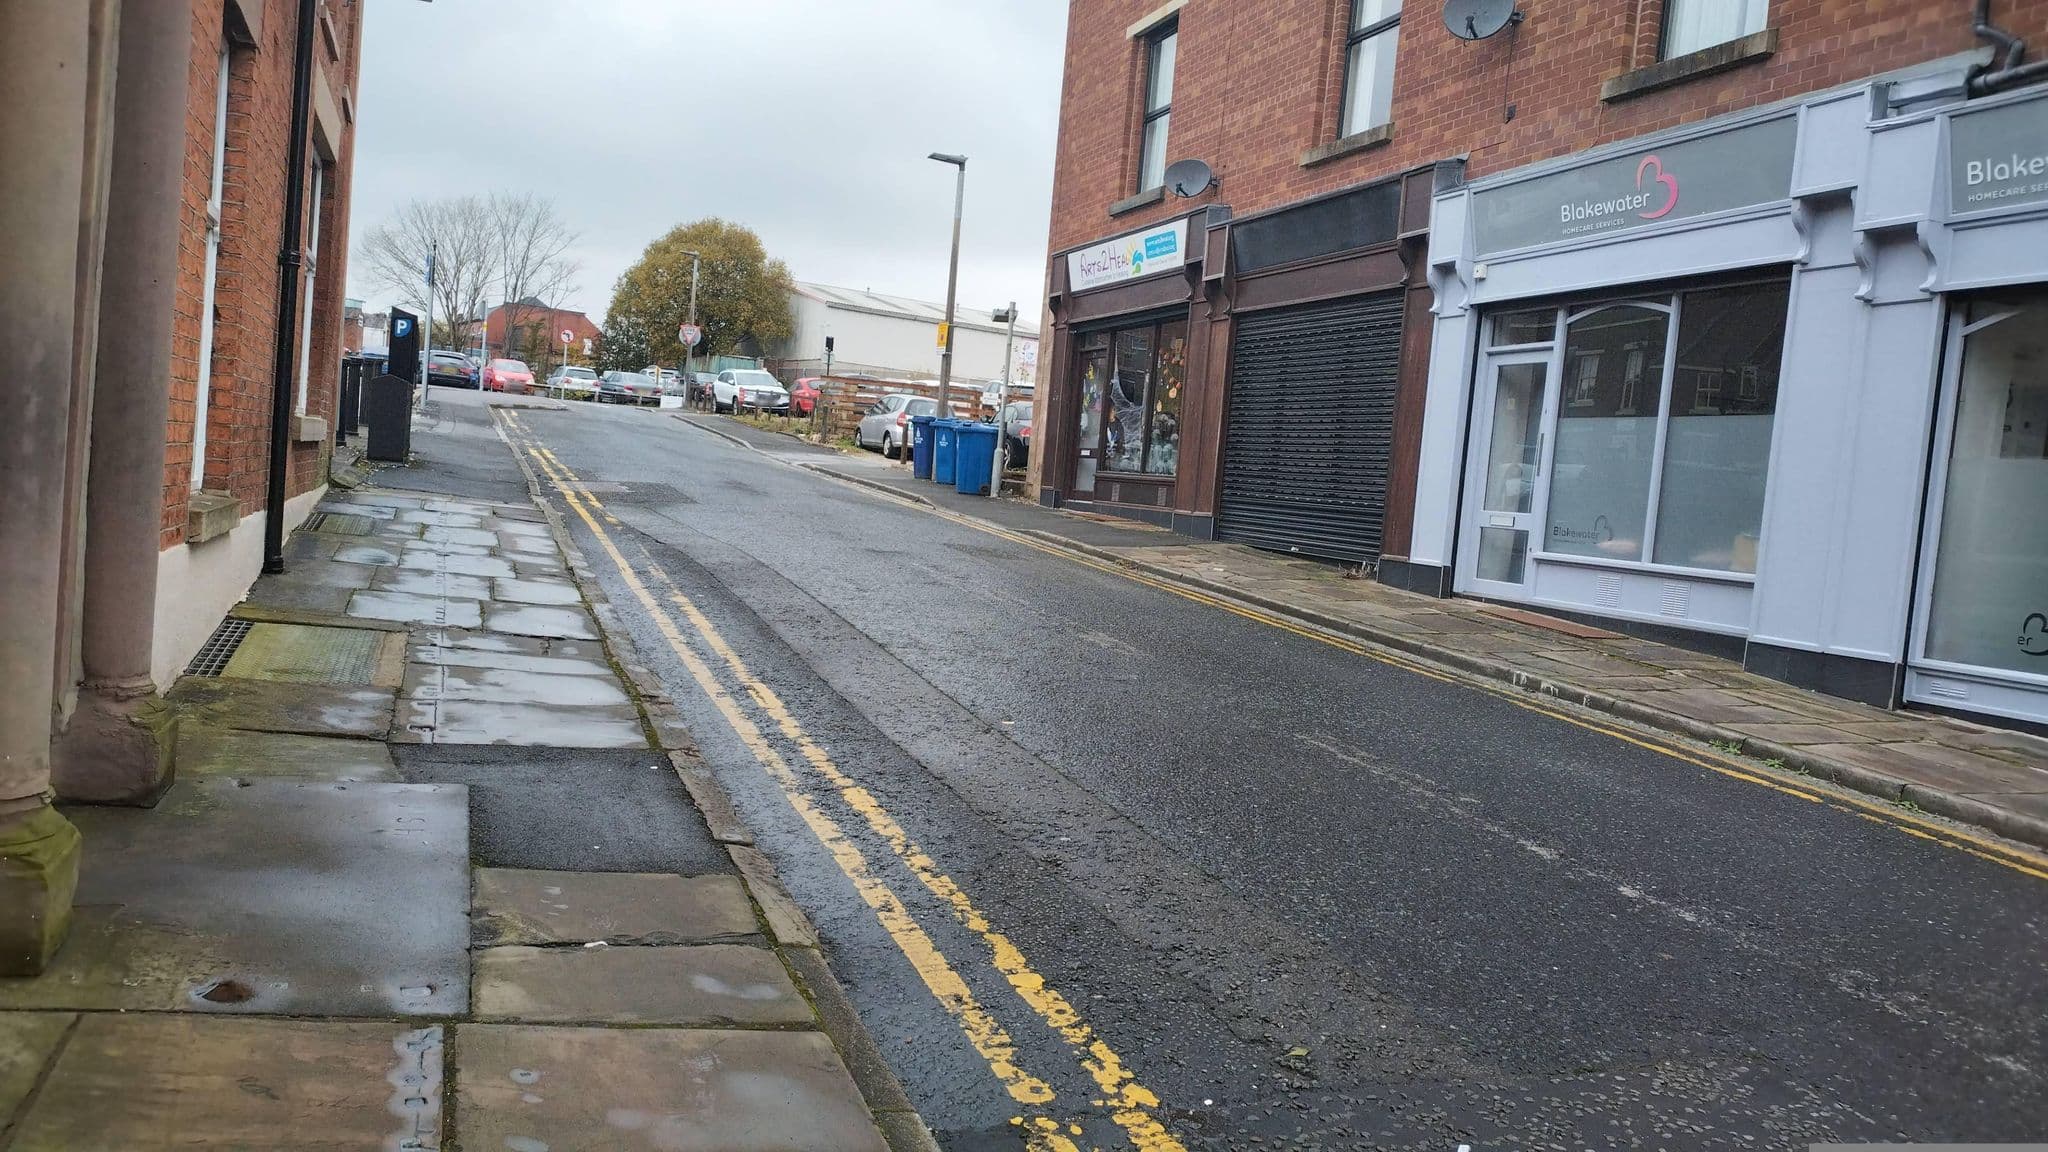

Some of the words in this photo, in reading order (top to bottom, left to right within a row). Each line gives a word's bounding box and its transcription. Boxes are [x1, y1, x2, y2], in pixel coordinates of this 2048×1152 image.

[1967, 153, 2048, 185] Blake
[1968, 186, 2027, 202] HOMECARE
[1561, 193, 1650, 222] Blakewater
[1562, 223, 1594, 235] HOMECARE
[1596, 218, 1625, 229] SERVICES
[397, 319, 408, 334] P
